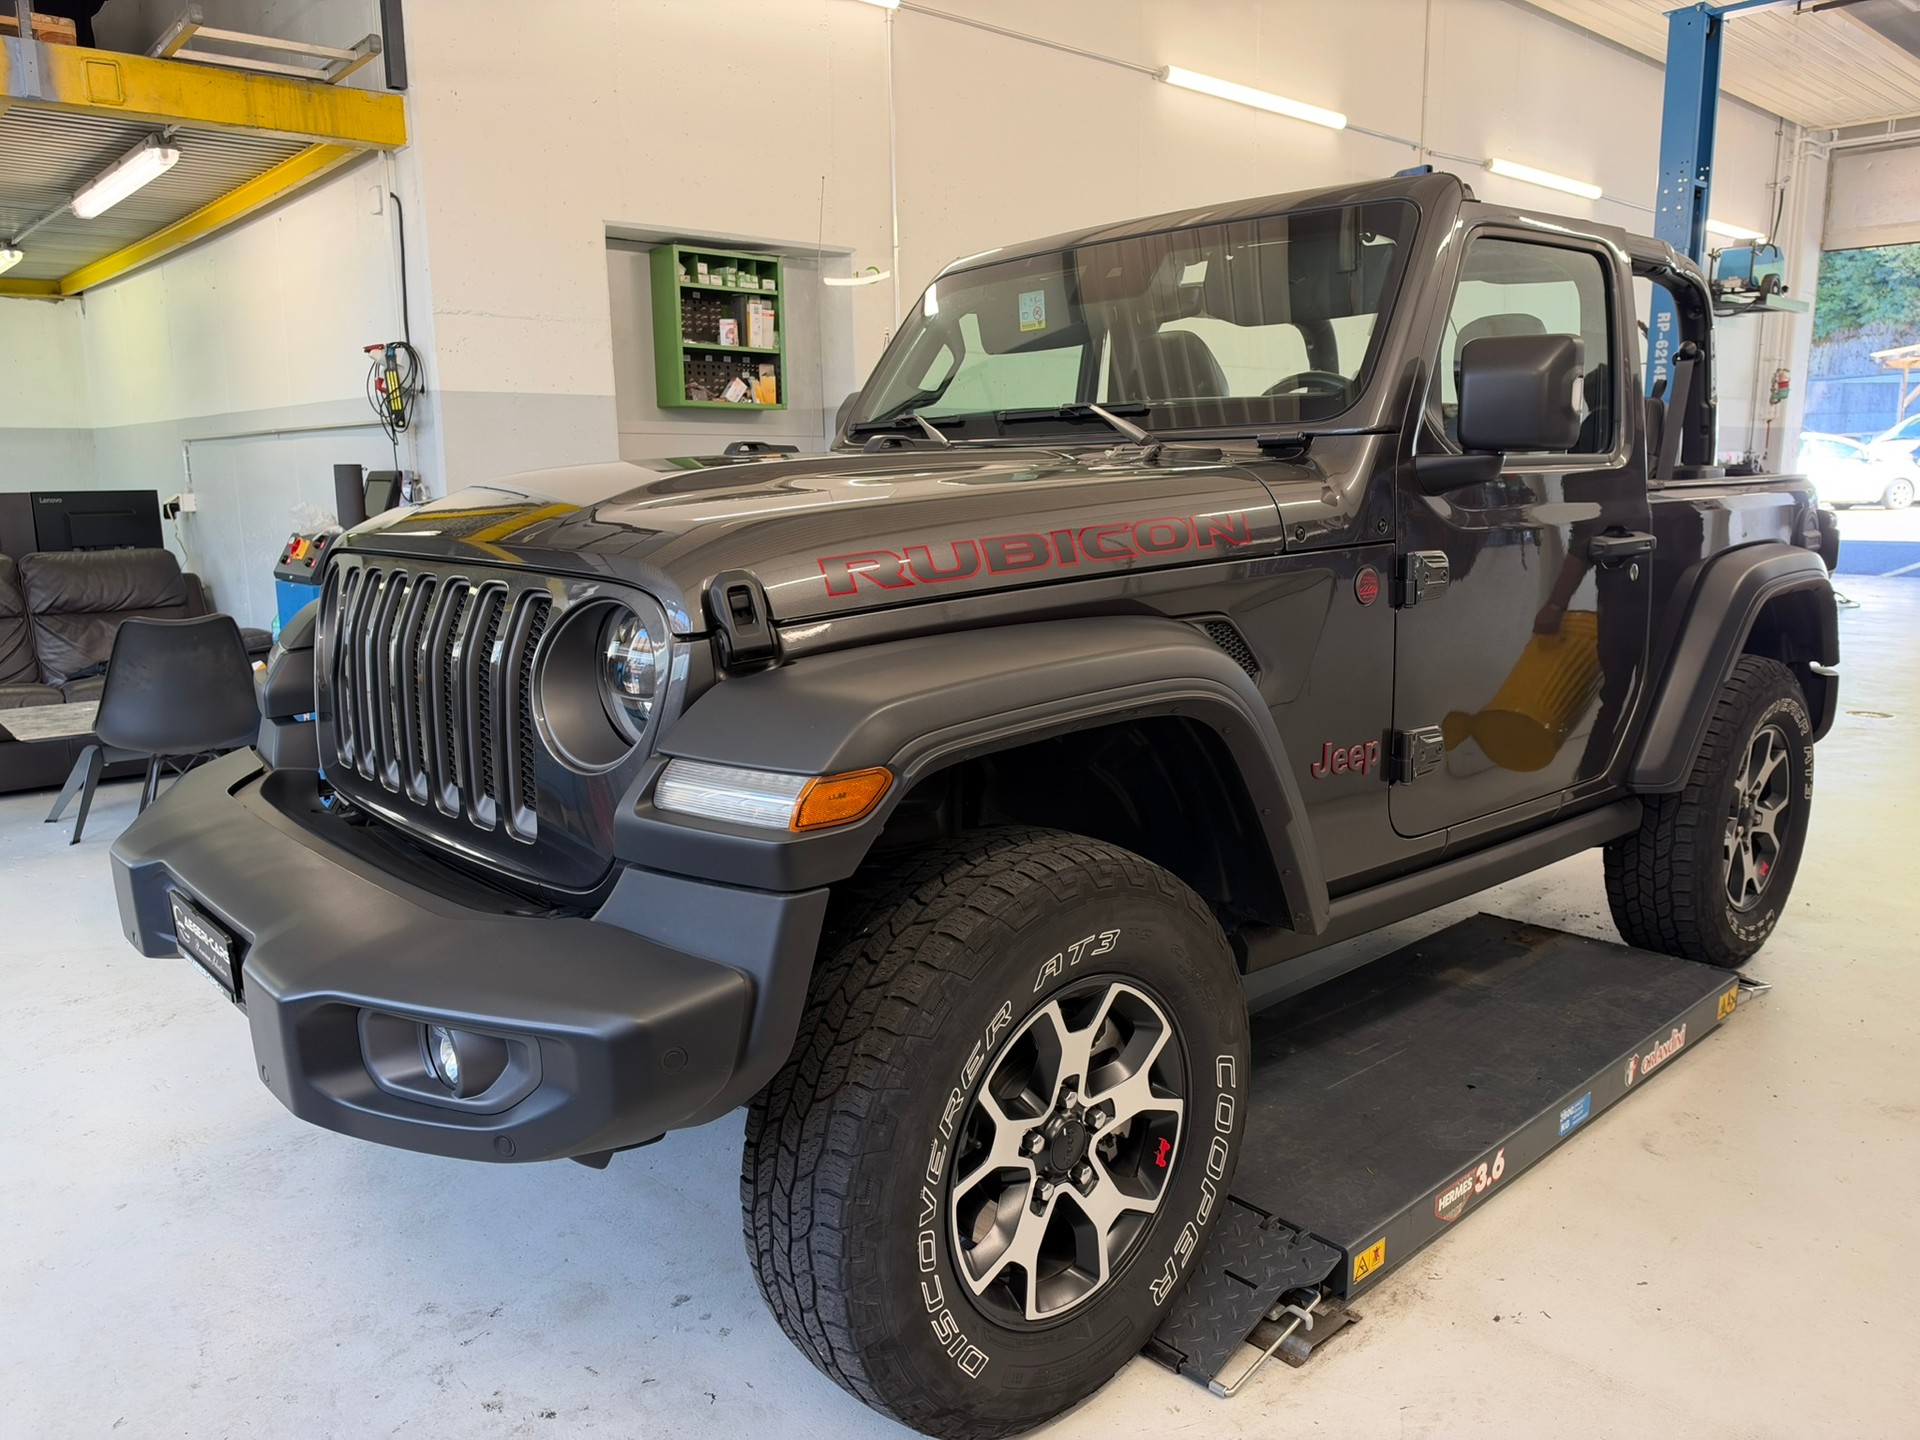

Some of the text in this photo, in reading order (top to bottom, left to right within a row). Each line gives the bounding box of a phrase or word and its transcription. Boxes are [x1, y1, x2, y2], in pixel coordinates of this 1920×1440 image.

[818, 512, 1252, 597] RUBICON
[1311, 740, 1380, 779] Jeep
[918, 928, 1121, 1379] DISCOVERER AT3
[1149, 1055, 1236, 1307] COOPER
[1438, 1177, 1473, 1212] HERMES
[1475, 1147, 1505, 1194] 3.6
